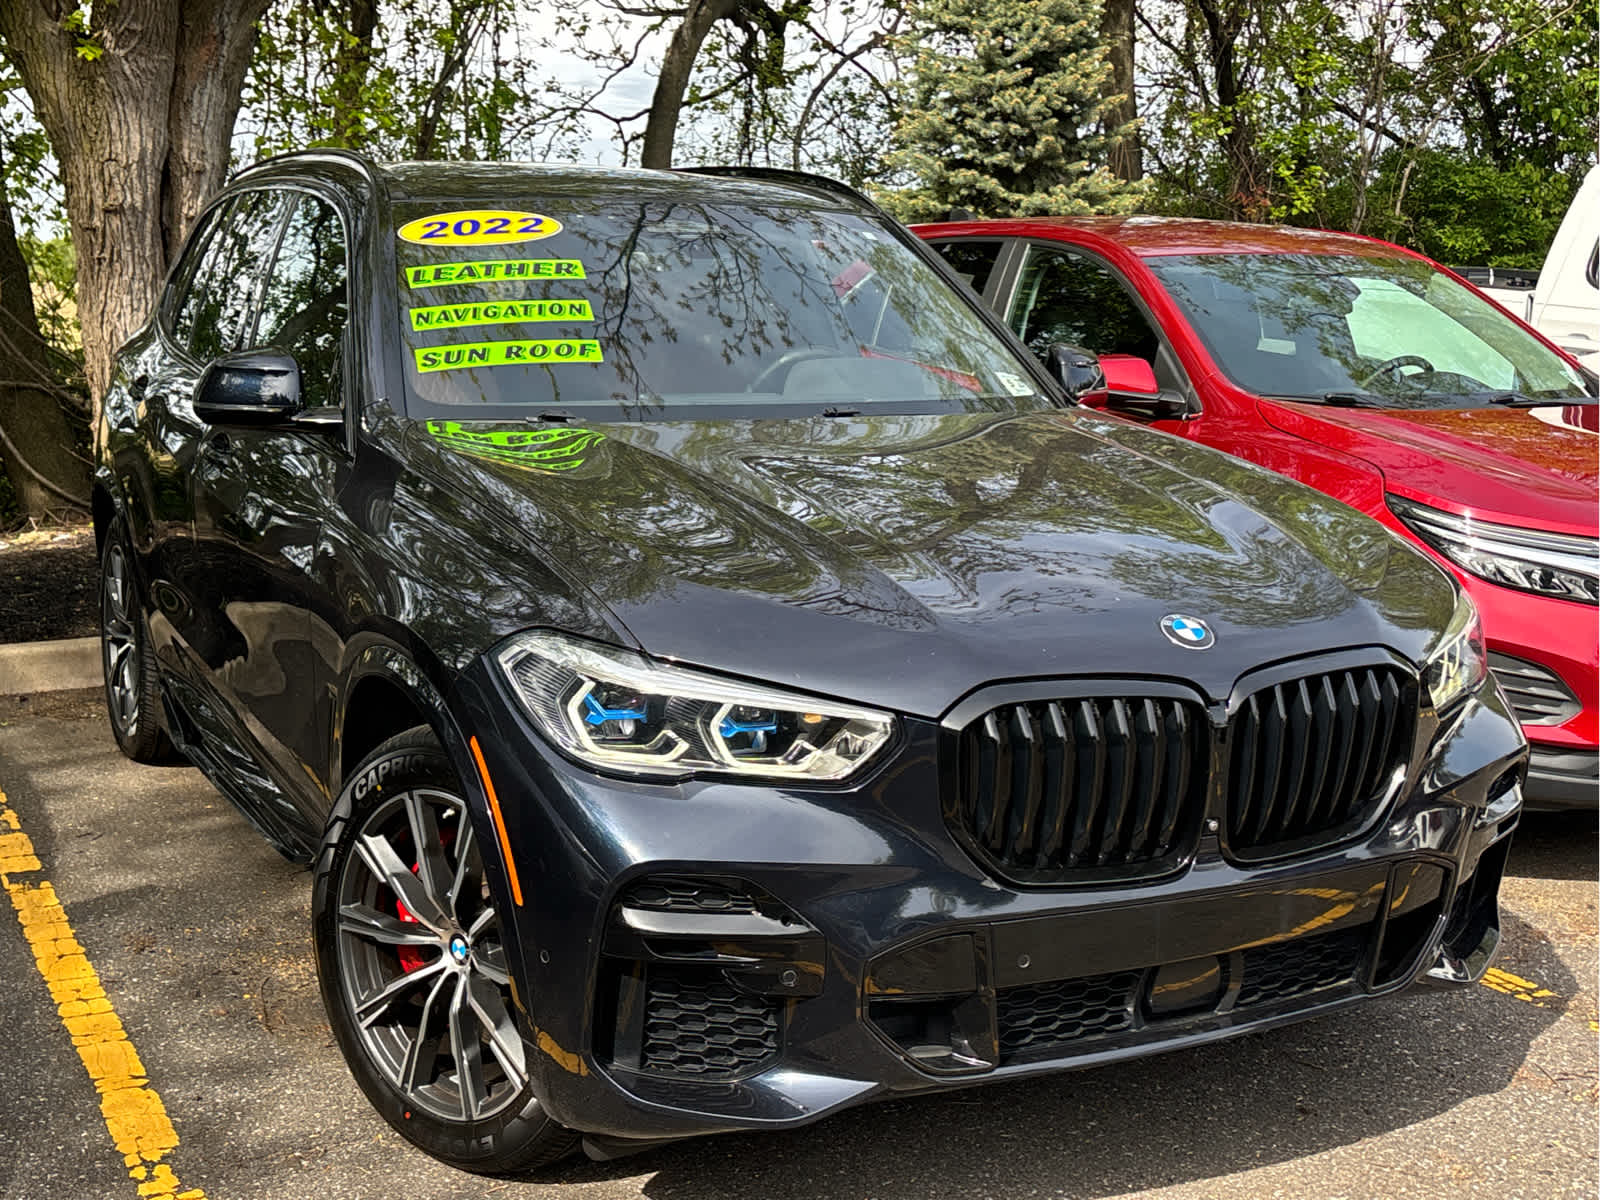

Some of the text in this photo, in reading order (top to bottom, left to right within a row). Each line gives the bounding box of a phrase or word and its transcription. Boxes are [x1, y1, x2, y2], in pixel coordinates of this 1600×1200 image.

[421, 217, 544, 239] 2022
[412, 262, 577, 284] LEATHER
[415, 303, 586, 326] NAVIGATION
[421, 343, 597, 368] SUN ROOF
